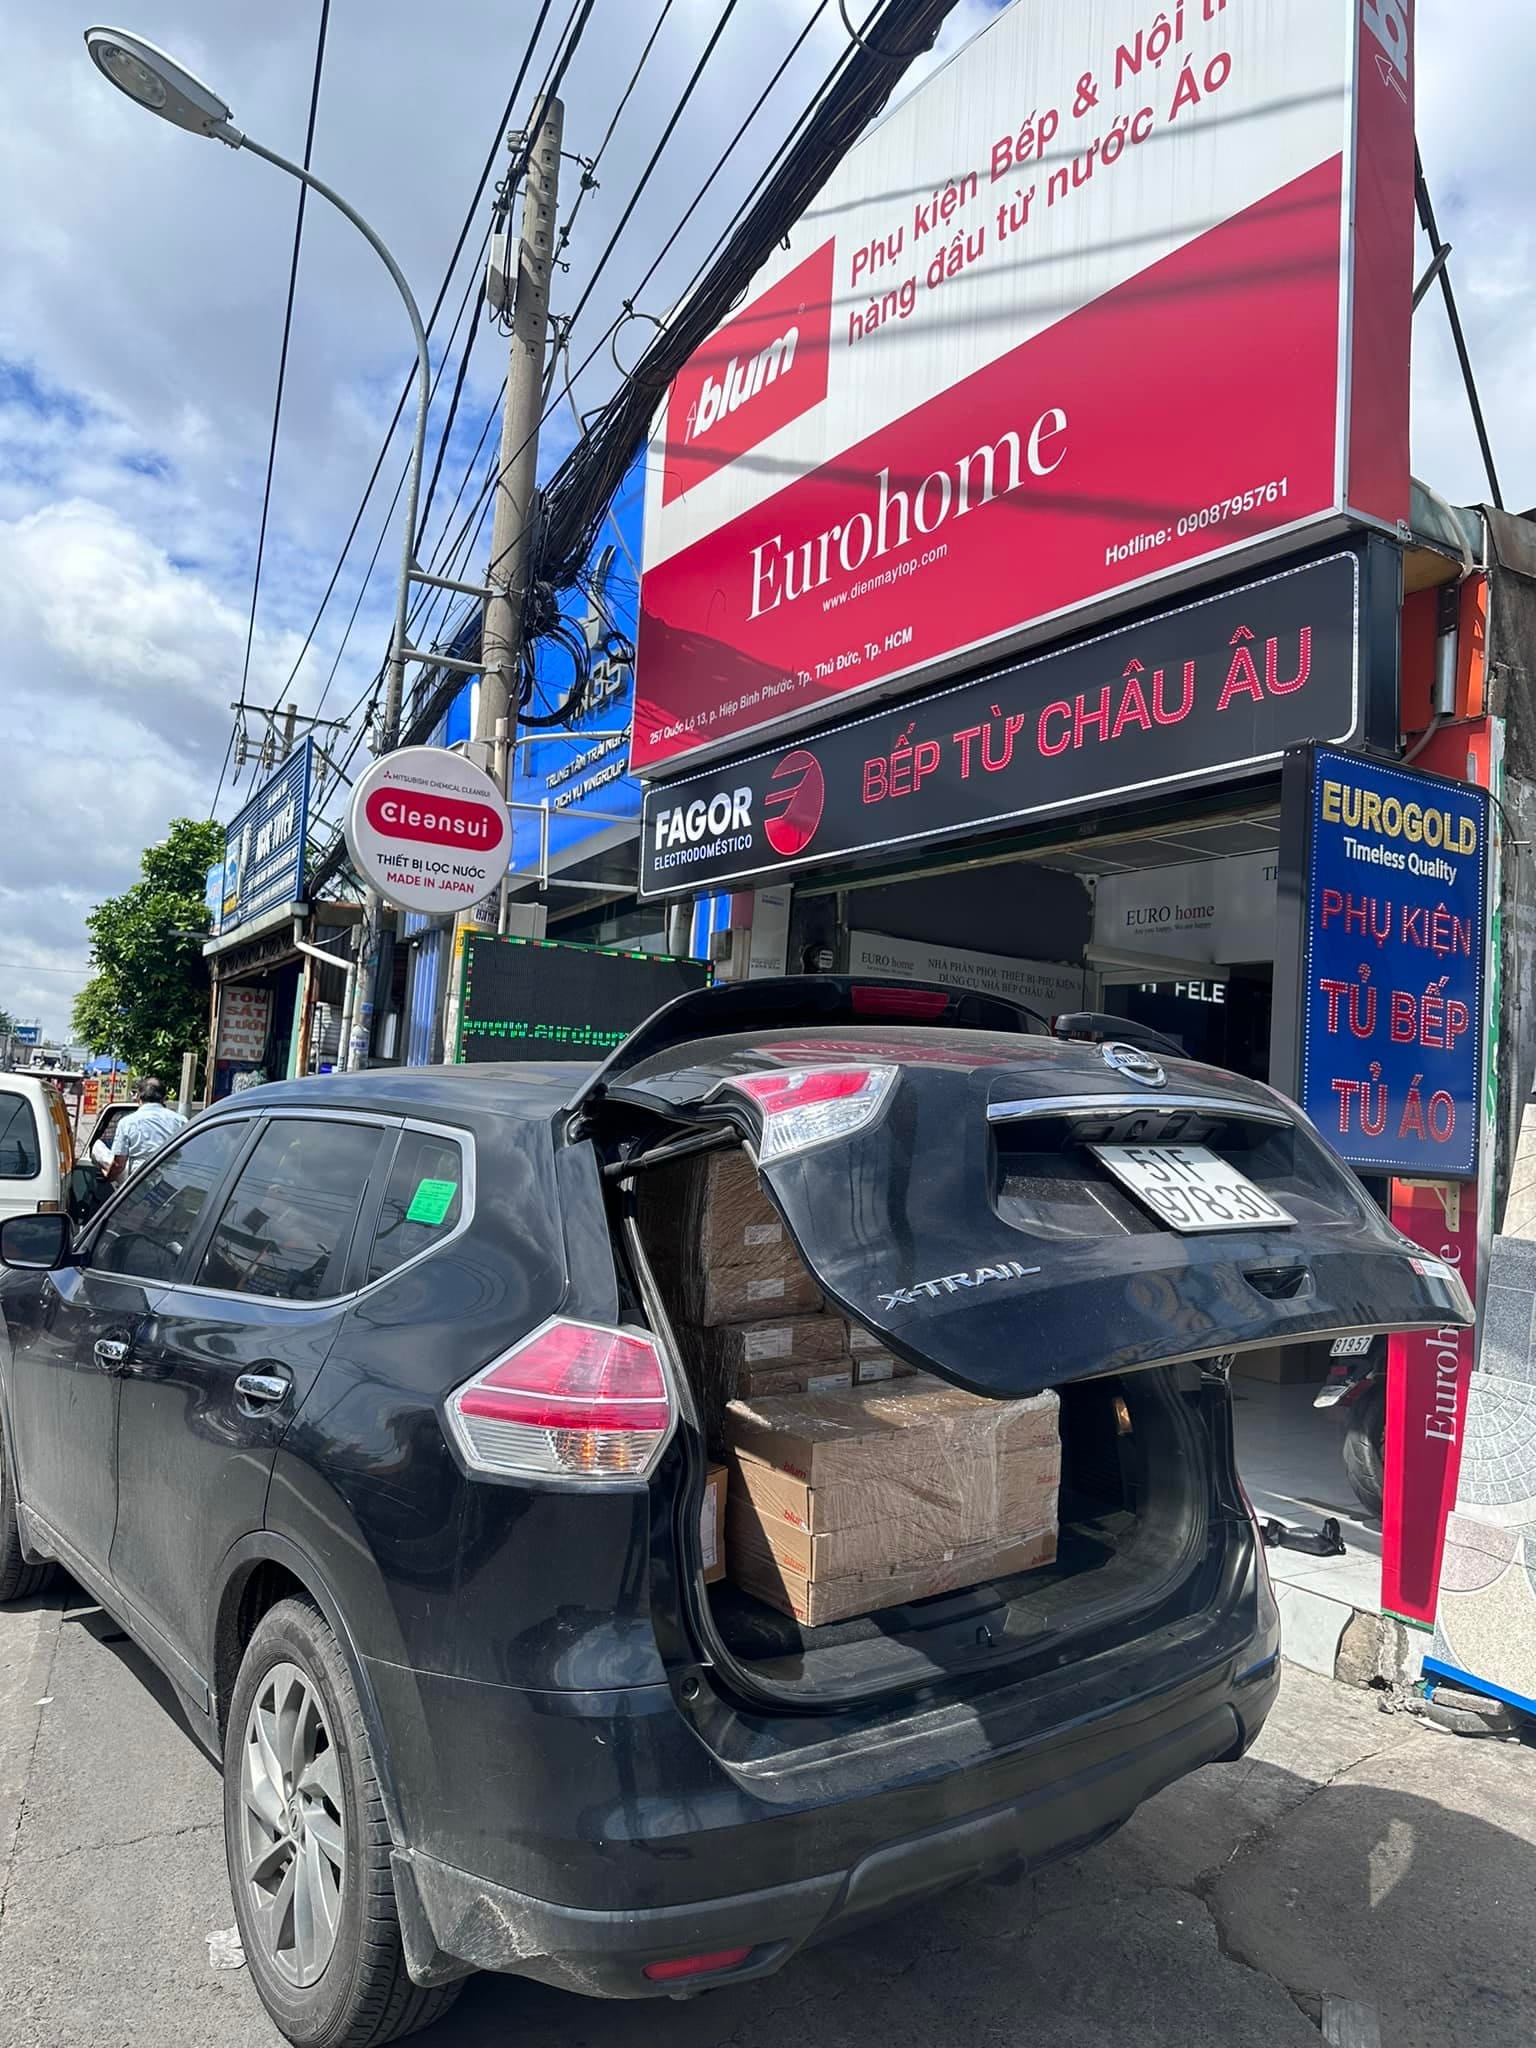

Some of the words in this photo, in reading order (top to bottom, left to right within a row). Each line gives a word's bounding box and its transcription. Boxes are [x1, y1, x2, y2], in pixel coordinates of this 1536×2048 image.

[852, 226, 903, 288] Phụ
[914, 171, 977, 240] kiện
[991, 107, 1059, 184] Bếp
[1073, 72, 1099, 118] &
[1115, 0, 1183, 89] Nội
[849, 276, 916, 346] hàng
[927, 227, 985, 289] đầu
[997, 184, 1036, 240] từ
[1048, 106, 1154, 207] nước
[1169, 52, 1231, 122] Áo
[692, 326, 800, 440] blum
[746, 407, 1068, 622] Eurohome
[1105, 526, 1172, 566] Hotline:
[1177, 477, 1288, 537] 0908795761
[822, 544, 948, 612] www.dienmaytop.com
[650, 730, 664, 745] 257
[663, 719, 685, 739] Quốc
[684, 717, 696, 733] Lộ
[696, 713, 709, 727] 13,
[709, 711, 719, 725] p.
[719, 699, 739, 718] Hiệp
[761, 678, 796, 701] Phước,
[797, 670, 814, 689] Tp.
[814, 656, 836, 680] Thủ
[836, 649, 862, 671] Đức,
[864, 641, 883, 661] Tp.
[884, 626, 914, 652] HCM
[861, 722, 942, 804] BẾP
[953, 704, 1026, 781] TỪ
[1037, 658, 1197, 758] CHÂU
[1216, 625, 1313, 713] ÂU
[393, 773, 430, 788] MITSUBISHI
[430, 780, 461, 793] CHEMICAL
[461, 786, 491, 798] CLEANSUI
[583, 758, 626, 793] VINGROUP
[380, 801, 489, 838] Cleansui
[655, 786, 753, 851] FAGOR
[1321, 779, 1478, 856] EUROGOLD
[377, 853, 410, 868] THIẾT
[412, 859, 424, 873] BỊ
[426, 862, 451, 876] LỌC
[453, 864, 487, 880] NƯỚC
[386, 872, 422, 886] MADE
[423, 877, 436, 888] IN
[438, 880, 475, 894] JAPAN
[654, 833, 753, 871] ELECTRODOMÉSTICO
[1343, 836, 1406, 872] Timeless
[1407, 851, 1458, 887] Quality
[1126, 905, 1172, 927] EURO
[1174, 904, 1216, 921] home
[1320, 888, 1393, 949] PHỤ
[1401, 901, 1473, 959] KIỆN
[861, 952, 891, 968] EURO
[891, 955, 916, 970] home
[1319, 962, 1377, 1039] TỦ
[1390, 975, 1470, 1050] BẾP
[1331, 1060, 1388, 1137] TỦ
[1397, 1073, 1457, 1143] ÁO
[1122, 1148, 1206, 1184] 51F
[1144, 1184, 1281, 1224] 978.30
[877, 1261, 1041, 1311] X-TRAIL
